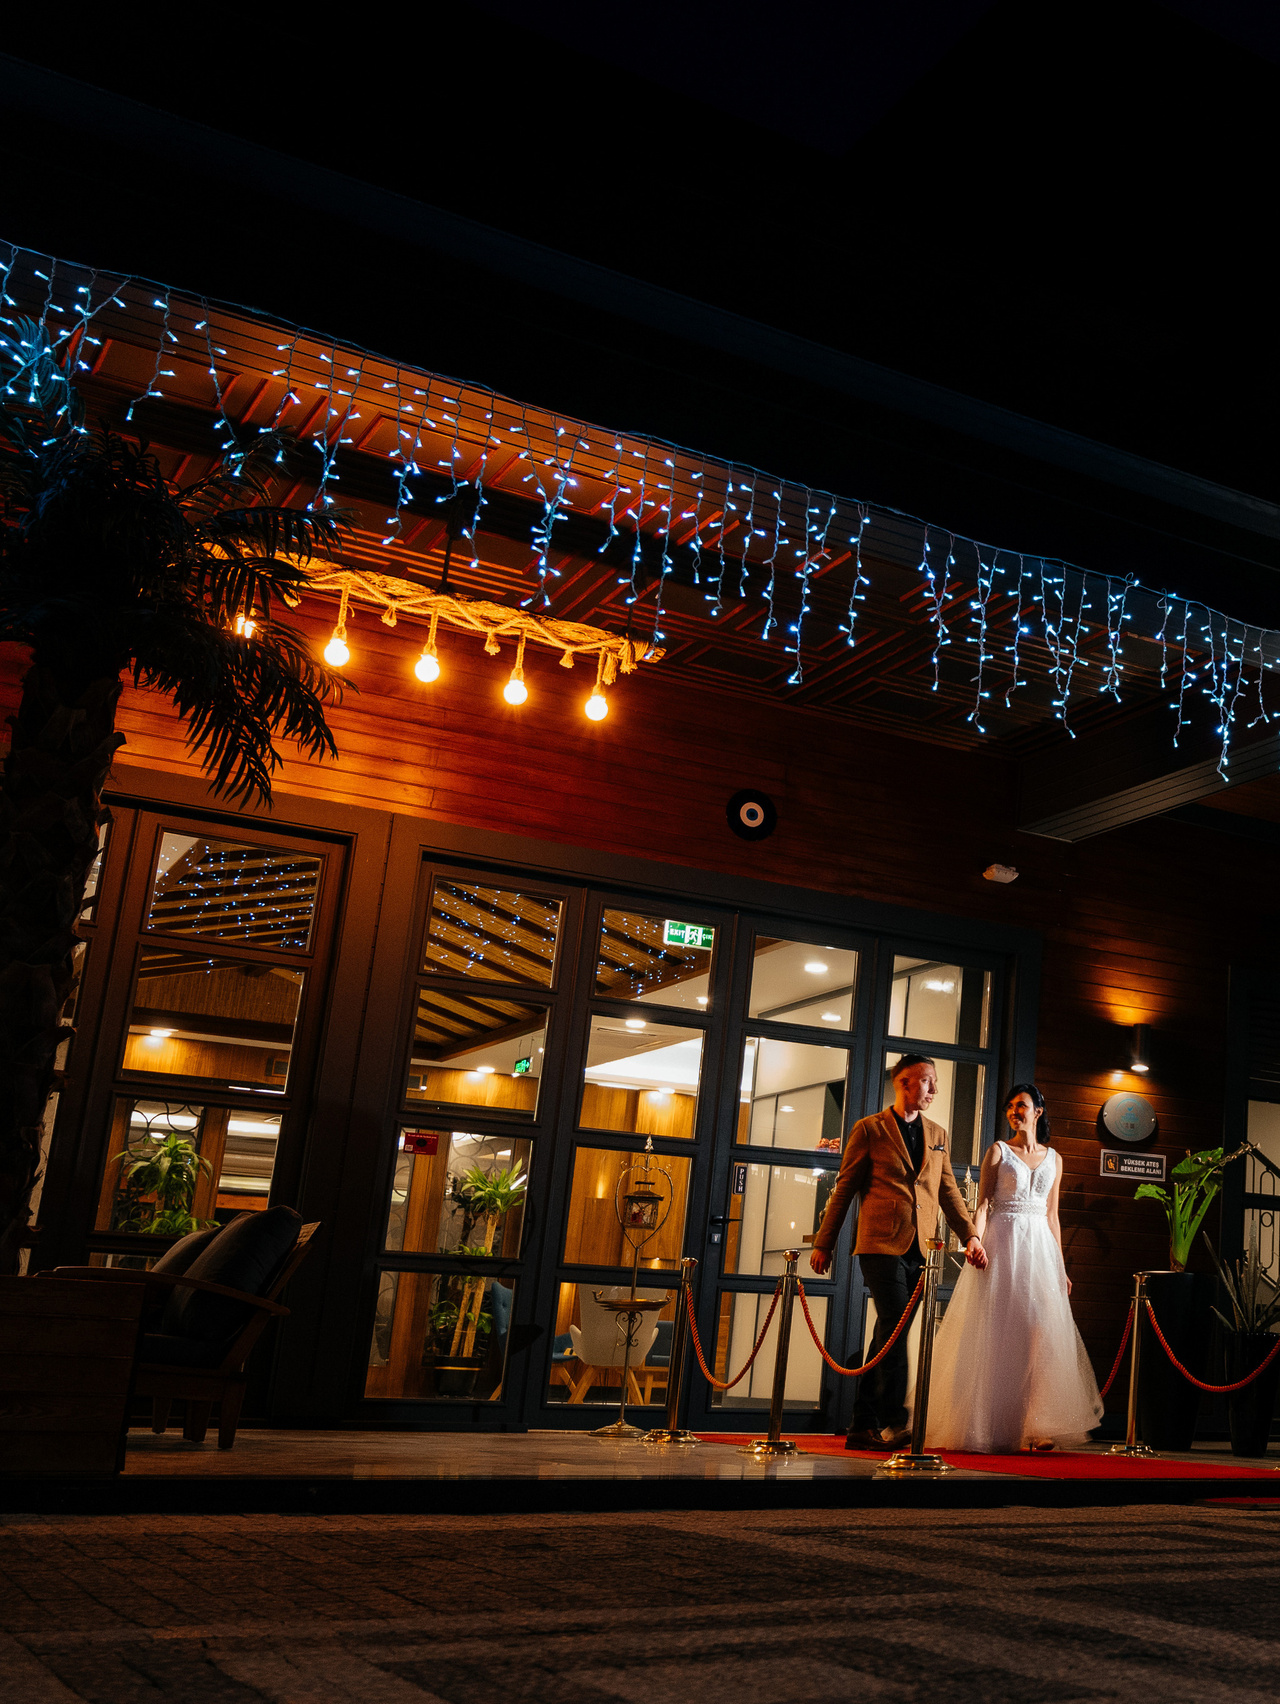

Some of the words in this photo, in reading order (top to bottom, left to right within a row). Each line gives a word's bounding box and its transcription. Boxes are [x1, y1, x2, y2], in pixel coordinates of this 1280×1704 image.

[669, 928, 686, 938] EXIT
[1123, 1158, 1145, 1166] YÜKSEK
[1146, 1160, 1160, 1168] ATEŞ
[1120, 1165, 1145, 1173] BEKLEME
[1146, 1167, 1162, 1175] ALANI
